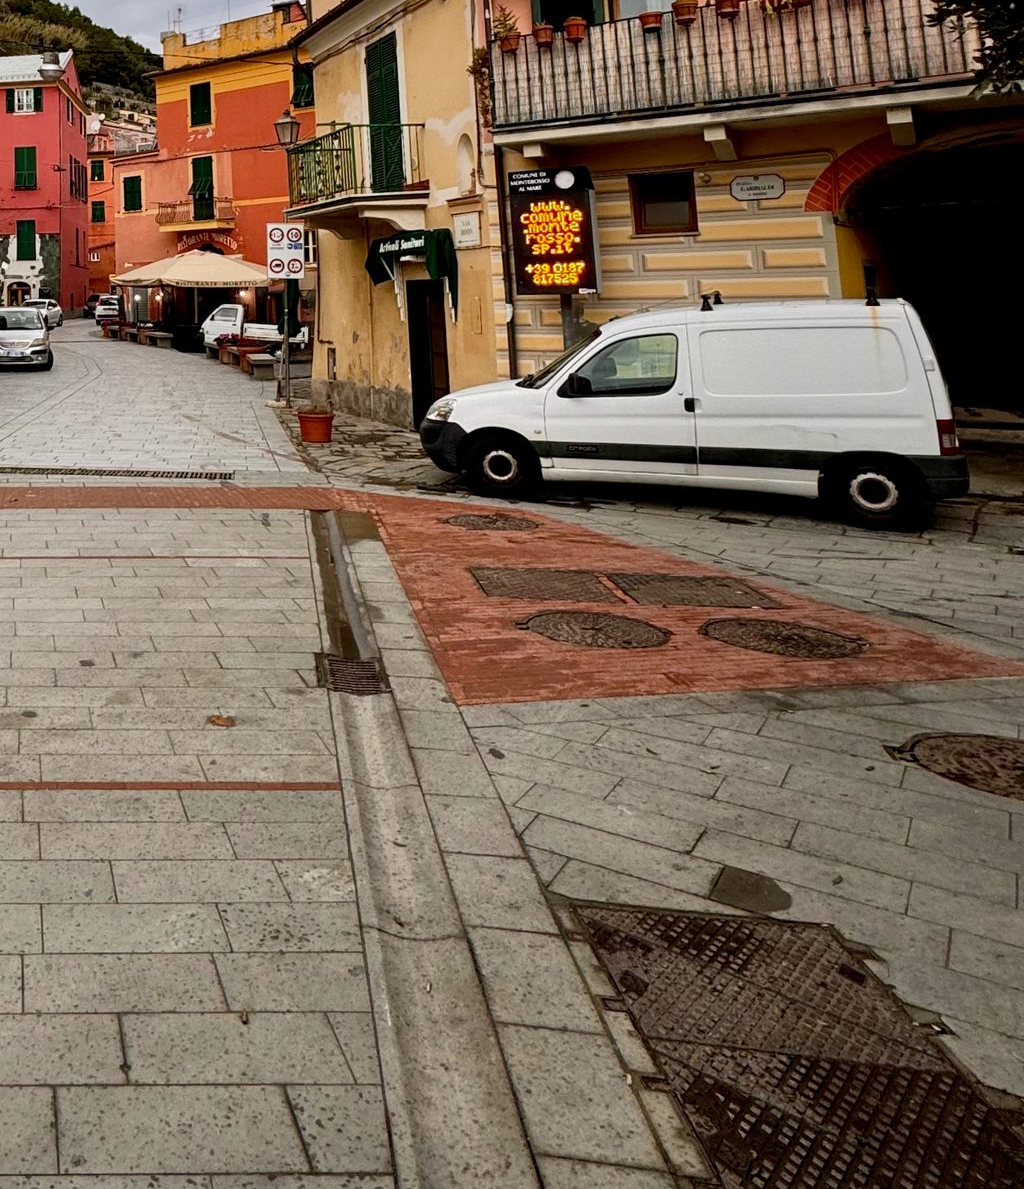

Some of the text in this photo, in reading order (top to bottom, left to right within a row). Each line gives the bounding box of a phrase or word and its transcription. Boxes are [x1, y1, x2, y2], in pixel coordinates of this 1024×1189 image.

[510, 178, 550, 186] MONTEROSSO
[512, 172, 538, 180] COMUNE
[520, 210, 583, 224] comune
[177, 232, 238, 252] RISTORANTE MORETTO
[379, 235, 425, 253] Articoli Sanitari
[525, 261, 585, 274] +39 0187
[532, 273, 579, 285] 817525
